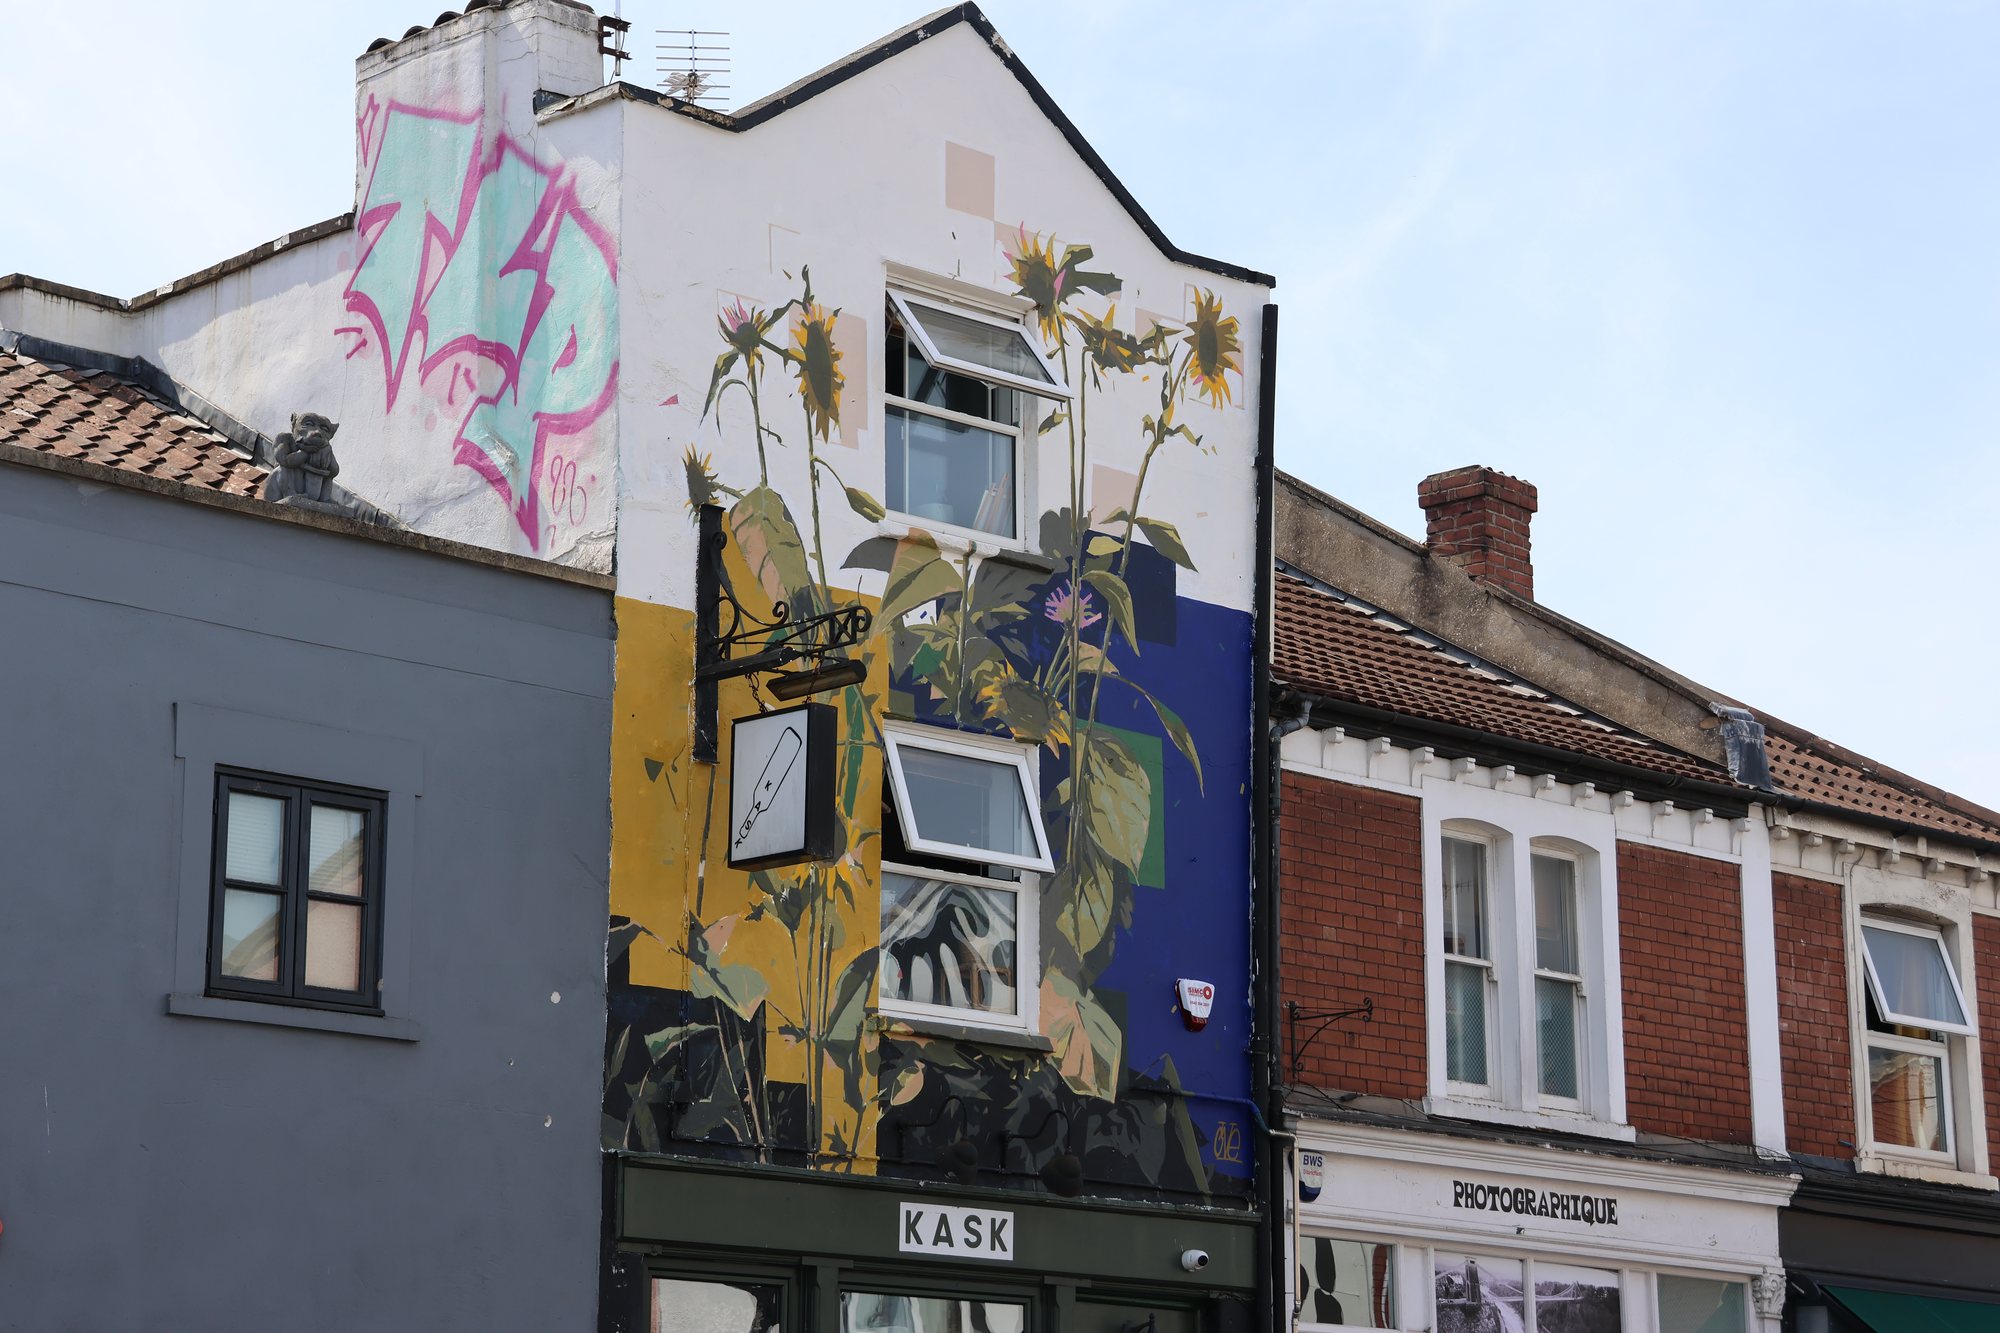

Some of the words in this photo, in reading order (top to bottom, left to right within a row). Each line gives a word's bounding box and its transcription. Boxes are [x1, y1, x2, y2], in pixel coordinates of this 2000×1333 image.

[1303, 1154, 1323, 1168] BWS
[1453, 1180, 1618, 1226] PHOTOGRAPHIQUE
[905, 1209, 1009, 1252] KASK
